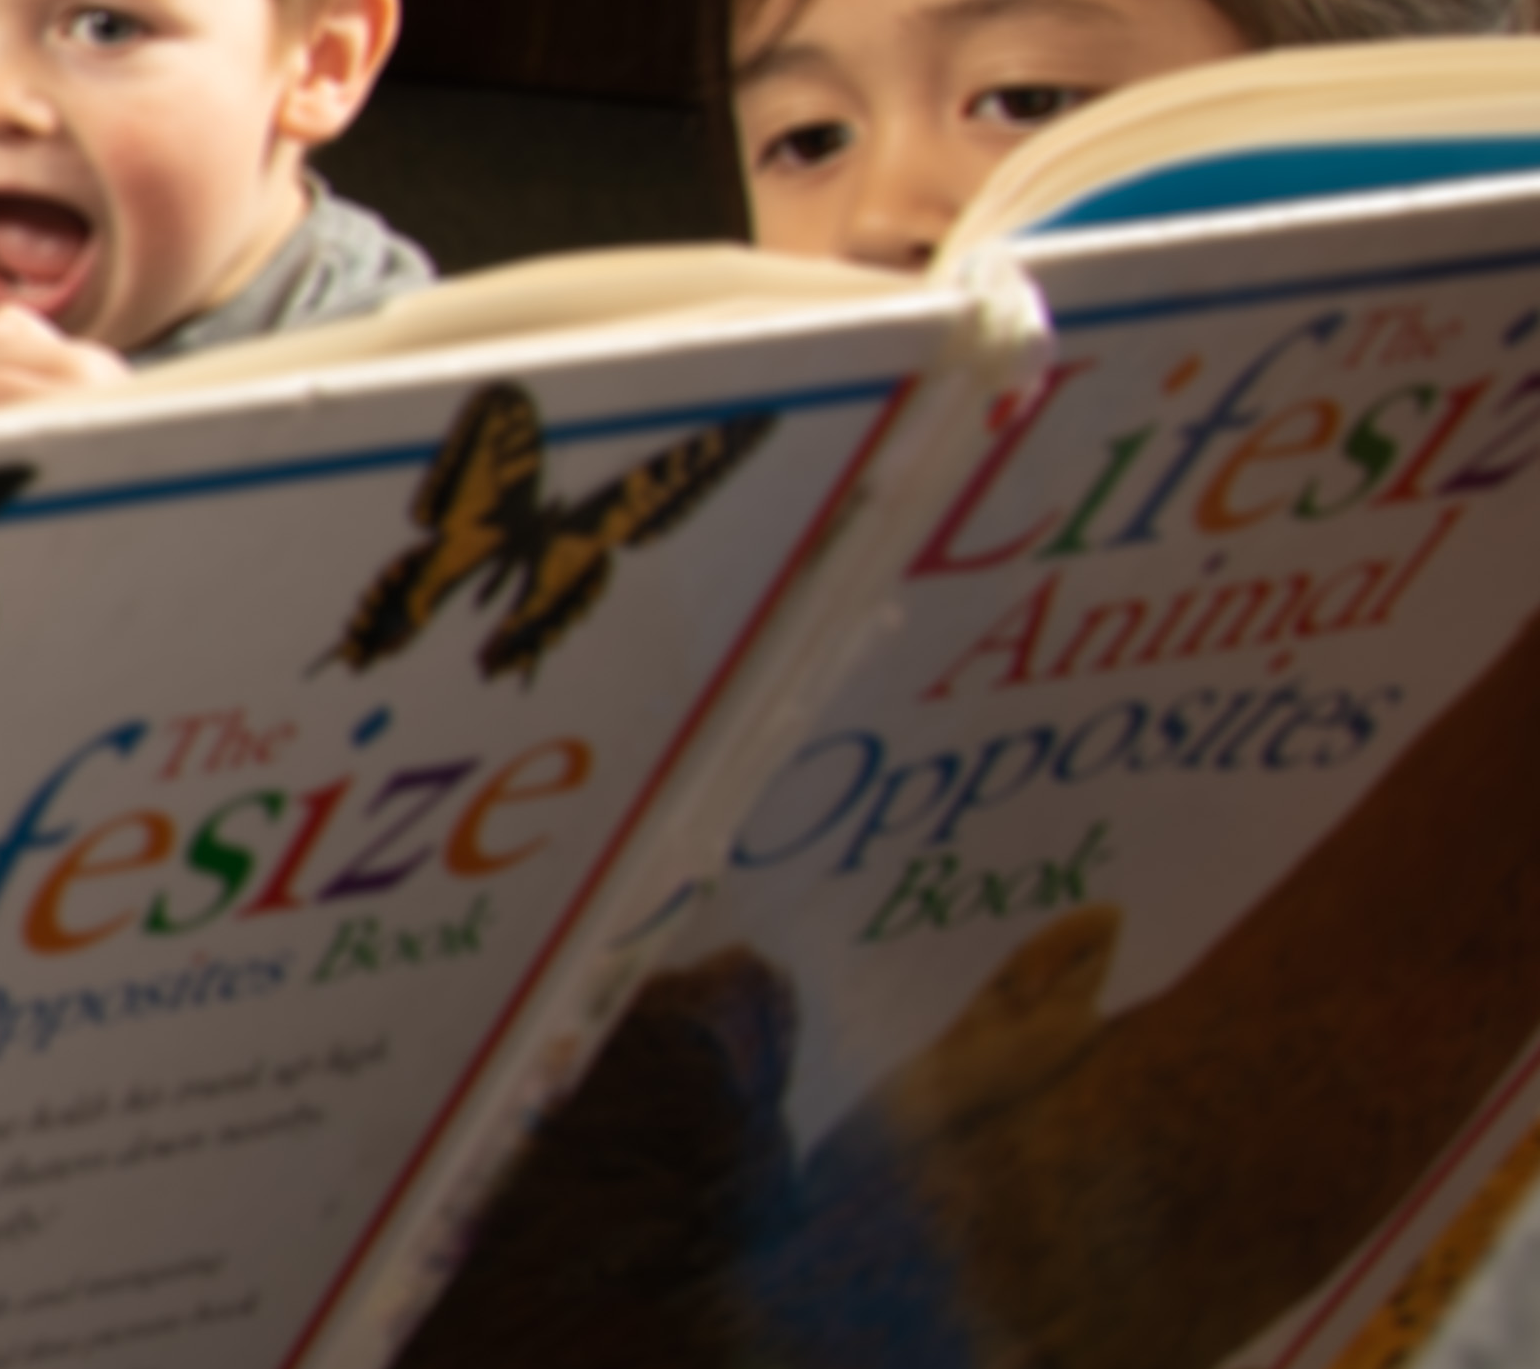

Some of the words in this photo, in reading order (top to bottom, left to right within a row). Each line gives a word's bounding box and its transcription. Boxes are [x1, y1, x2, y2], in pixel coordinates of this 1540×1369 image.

[1342, 301, 1467, 371] The
[918, 503, 1472, 703] Animal
[152, 703, 302, 785] The
[728, 661, 1404, 877] Opposites
[860, 819, 1118, 945] Book
[308, 889, 498, 991] Book
